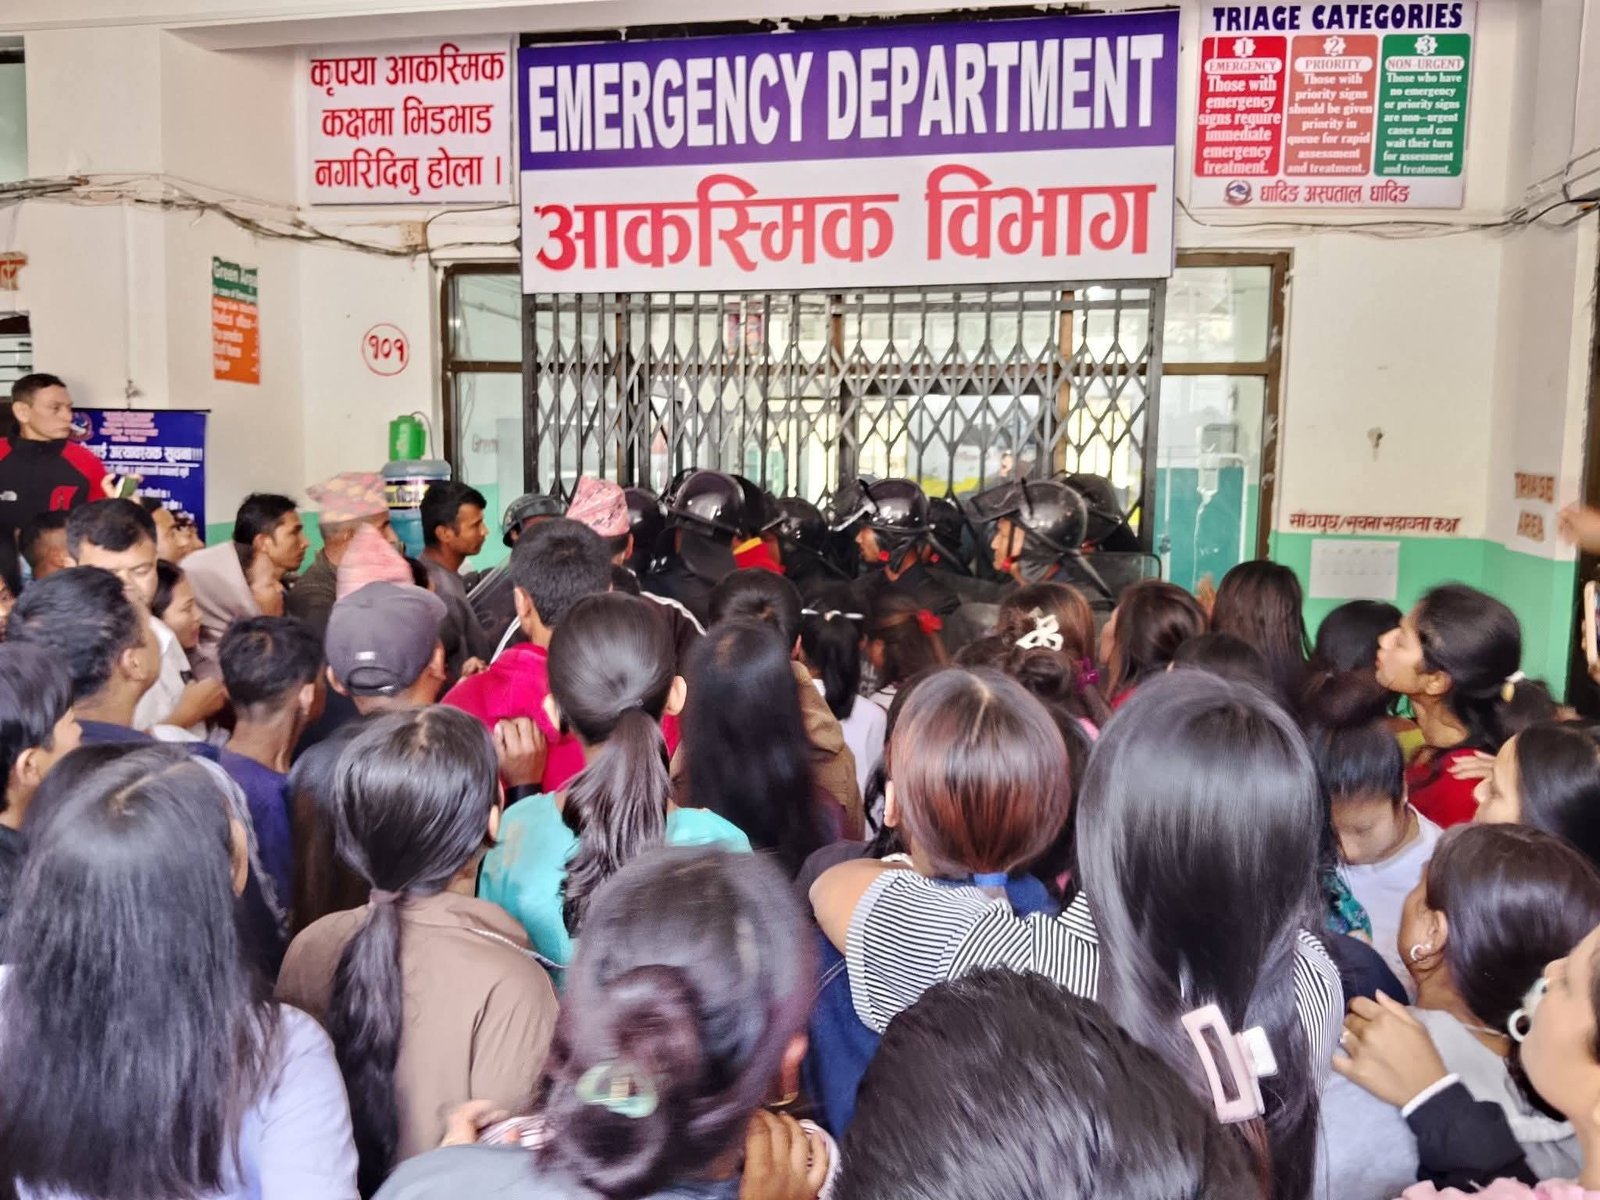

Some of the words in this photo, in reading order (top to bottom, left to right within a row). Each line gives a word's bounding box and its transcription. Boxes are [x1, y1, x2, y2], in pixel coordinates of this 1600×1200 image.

[1213, 6, 1301, 31] TRIAGE
[1312, 3, 1463, 30] CATEGORIES
[1329, 39, 1340, 55] 2
[1420, 38, 1431, 53] 3
[310, 57, 377, 97] कृपया
[385, 43, 506, 85] आकस्मिक
[1209, 60, 1277, 72] EMERGENCY
[1305, 58, 1361, 70] PRIORITY
[1207, 74, 1246, 92] Those
[1249, 74, 1277, 91] with
[1303, 73, 1336, 85] Those
[1339, 72, 1363, 84] with
[1386, 72, 1415, 83] Those
[1417, 72, 1438, 83] who
[1439, 71, 1462, 82] have
[529, 51, 814, 153] EMERGENCY
[827, 33, 1164, 140] DEPARTMENT
[1295, 88, 1337, 102] priority
[1339, 88, 1368, 101] signs
[1390, 88, 1402, 96] no
[1404, 88, 1456, 97] emergency
[1205, 96, 1276, 112] emergency
[1288, 102, 1325, 115] should
[1327, 102, 1342, 114] be
[1343, 103, 1373, 116] given
[1384, 101, 1395, 109] or
[1397, 99, 1433, 110] priority
[1434, 99, 1460, 110] signs
[322, 107, 395, 140] कक्षमा
[403, 96, 494, 135] भिडभाड
[1199, 109, 1232, 129] signs
[1234, 112, 1281, 129] require
[1301, 118, 1343, 131] priority
[1345, 117, 1357, 129] in
[1384, 114, 1399, 122] are
[1205, 126, 1272, 142] immediate
[1387, 127, 1414, 135] cases
[1415, 124, 1434, 135] and
[1435, 127, 1453, 135] can
[1287, 135, 1320, 146] queue
[1322, 132, 1339, 144] for
[1340, 132, 1371, 145] rapid
[1386, 138, 1406, 148] wait
[1407, 138, 1431, 148] their
[1432, 139, 1453, 148] turn
[1203, 146, 1273, 161] emergency
[1297, 149, 1360, 159] assessment
[1383, 150, 1398, 161] for
[1399, 152, 1454, 161] assessment
[314, 148, 420, 195] नगरिदिनु
[427, 147, 484, 188] होला
[1203, 160, 1269, 175] treatment.
[1287, 162, 1308, 173] and
[1383, 163, 1402, 174] and
[533, 173, 900, 272] आकस्मिक
[924, 163, 1157, 261] विभाग
